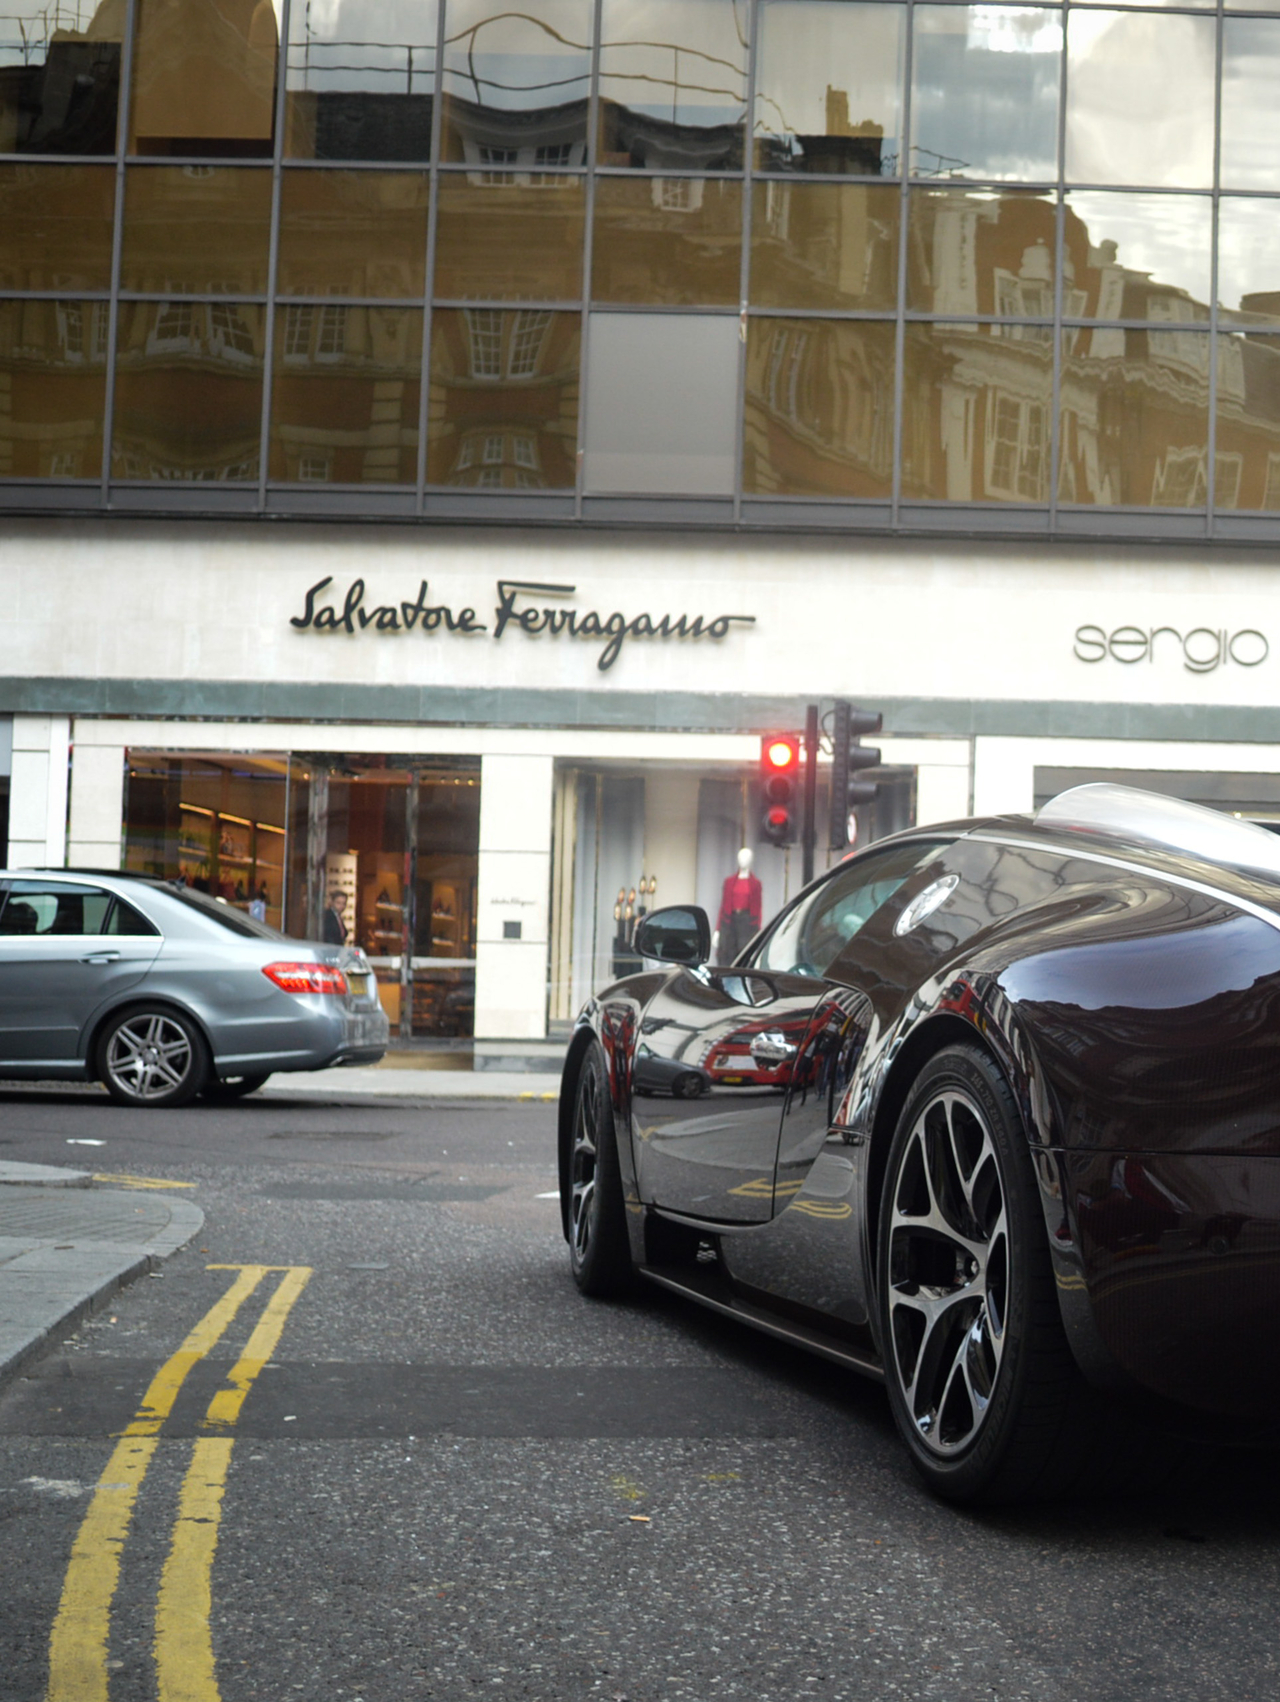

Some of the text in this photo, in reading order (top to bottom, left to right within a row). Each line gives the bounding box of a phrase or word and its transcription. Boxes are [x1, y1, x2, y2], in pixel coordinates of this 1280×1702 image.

[290, 576, 757, 671] Salvatore Ferragamo
[1073, 623, 1269, 674] sergio
